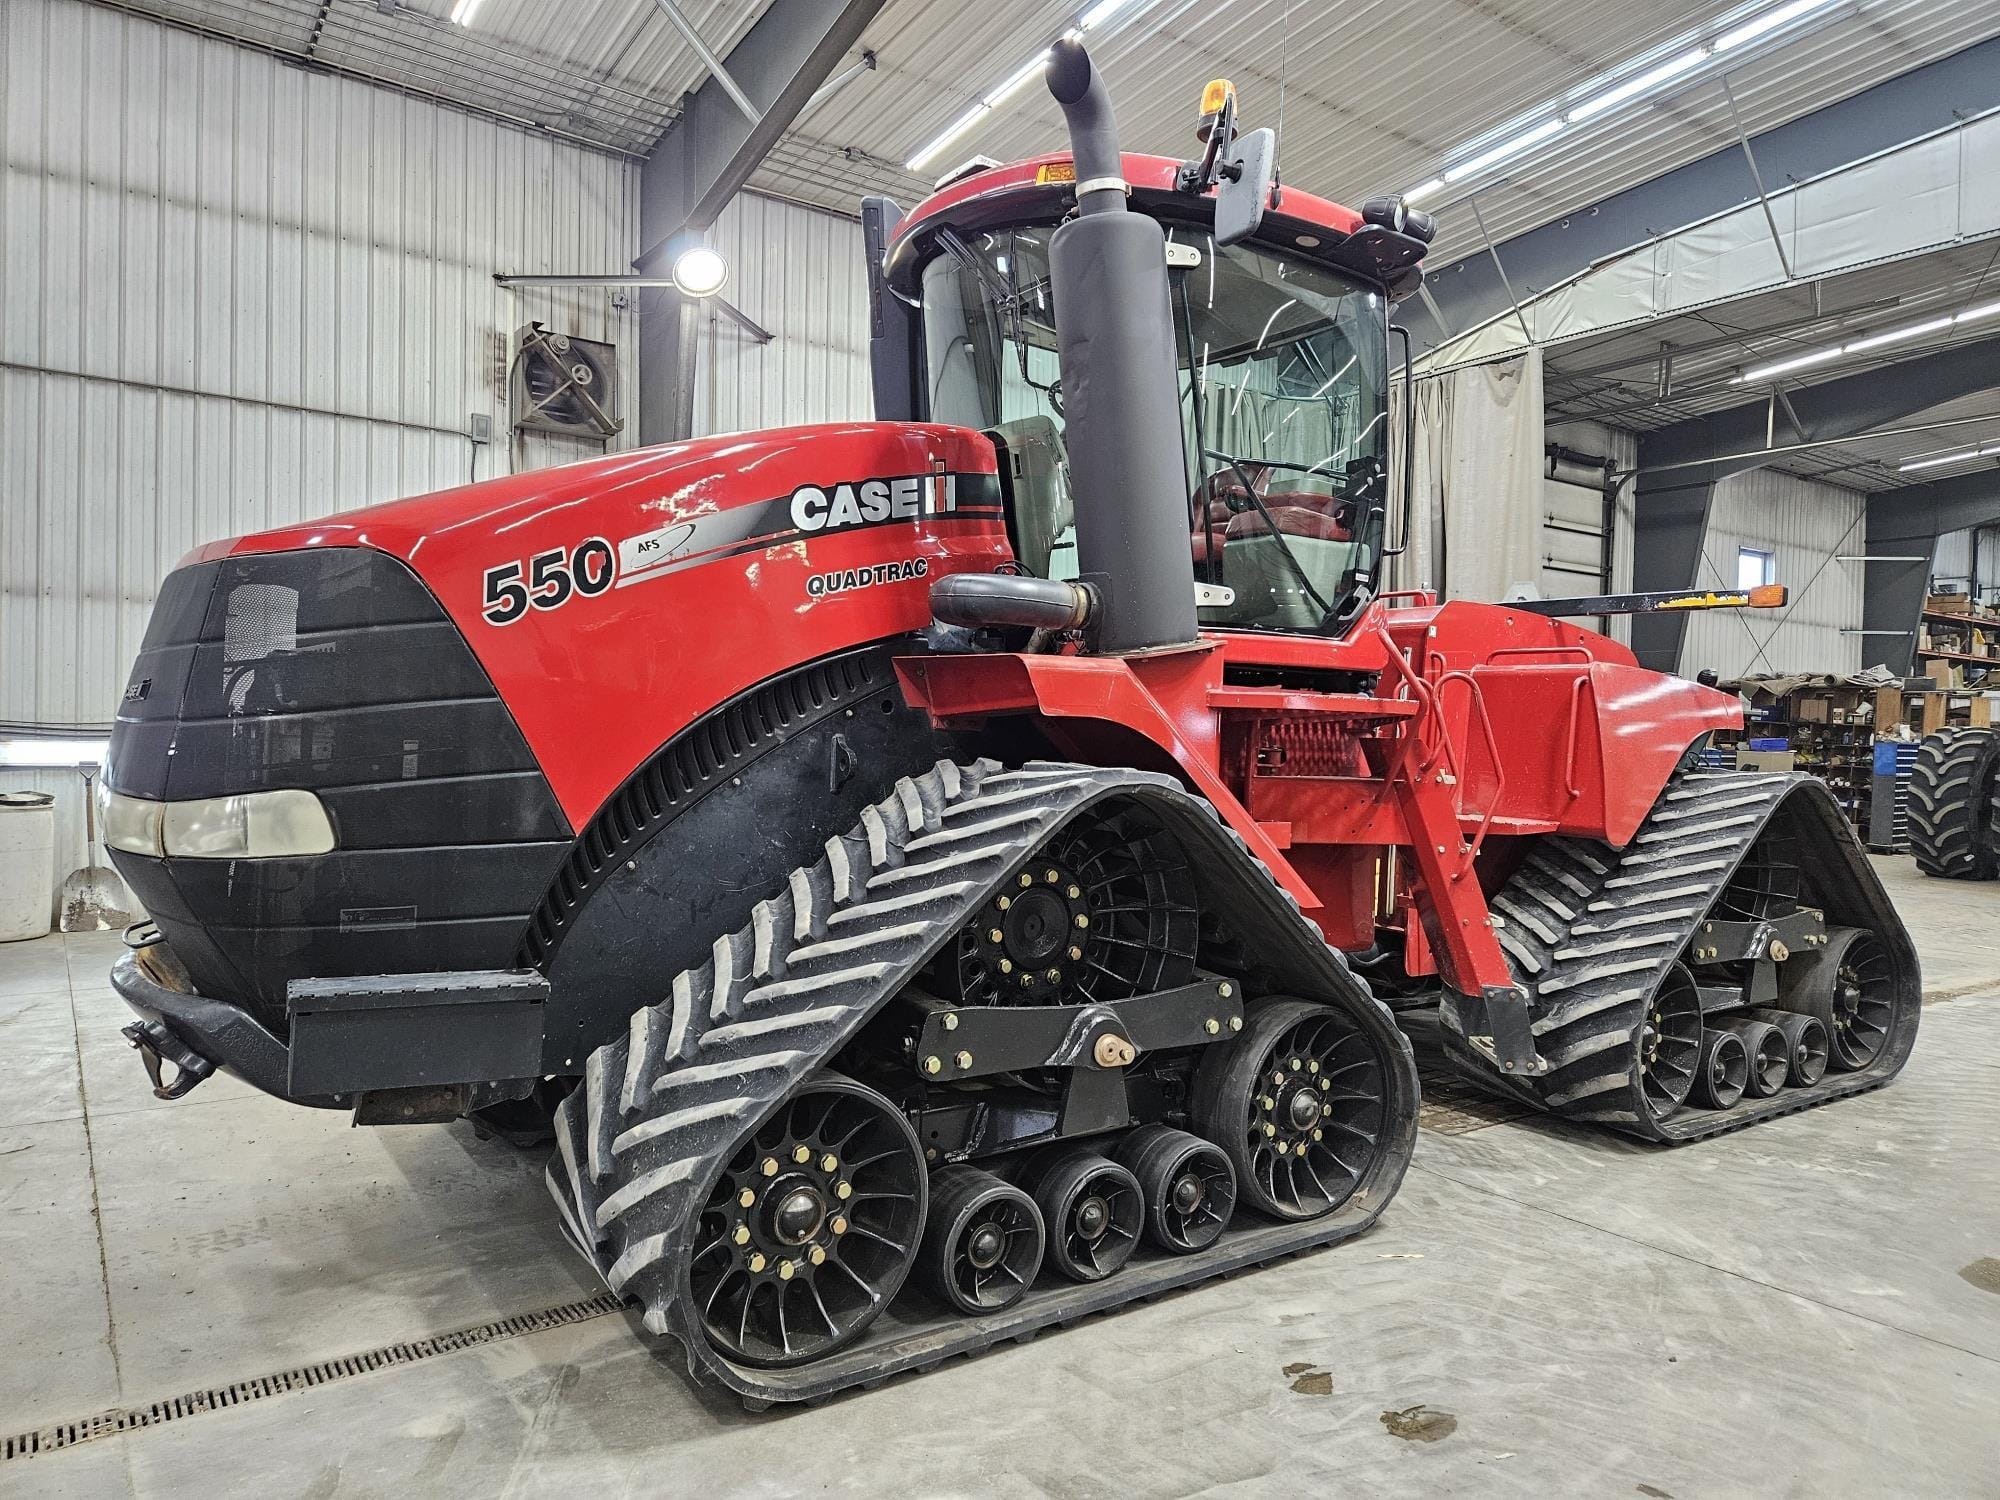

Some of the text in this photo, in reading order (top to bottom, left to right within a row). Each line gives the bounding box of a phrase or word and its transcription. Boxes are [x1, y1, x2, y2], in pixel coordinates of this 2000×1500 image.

[637, 538, 661, 554] AFS
[481, 536, 616, 627] 550
[806, 557, 929, 597] QUADTRAC
